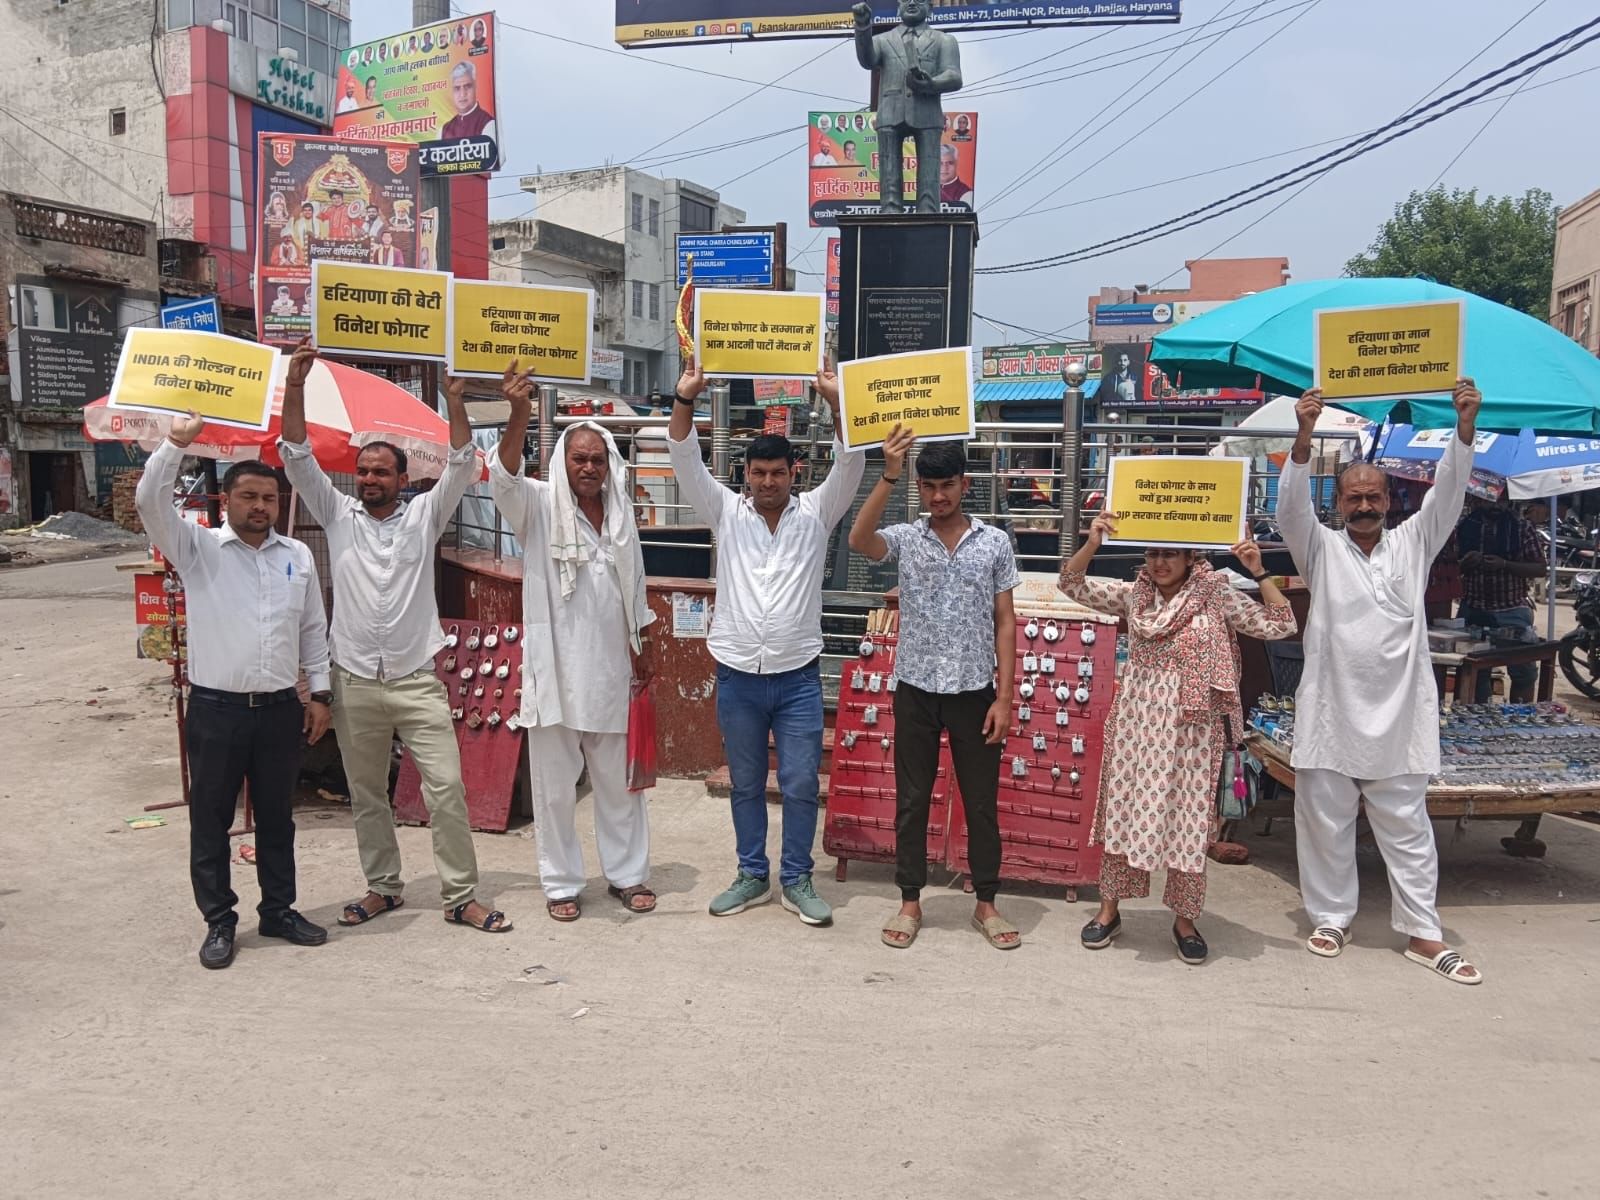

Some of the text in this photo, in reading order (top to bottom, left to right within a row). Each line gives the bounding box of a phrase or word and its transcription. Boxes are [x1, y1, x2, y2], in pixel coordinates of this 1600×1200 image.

[643, 28, 674, 38] Follow
[675, 27, 689, 36] us:
[959, 10, 992, 22] NH-71,
[993, 6, 1046, 19] Delhi-NCR,
[1048, 4, 1092, 17] Patauda,
[1093, 2, 1128, 16] Jhajjar,
[1129, 1, 1174, 13] Haryana
[269, 57, 315, 91] Hotel
[257, 79, 325, 119] Krishna
[276, 143, 289, 154] 15
[430, 138, 490, 163] कटारिया
[814, 178, 851, 197] हार्दिक
[323, 282, 442, 310] हरियाणा की बेटी
[193, 312, 214, 326] निषेध
[481, 306, 560, 323] हरियाणा का मान
[333, 313, 379, 335] विनेश
[383, 318, 430, 339] फोगाट
[490, 321, 550, 337] विनेश फोगाट
[703, 319, 816, 335] विनेश फोगाट के सम्मान में
[30, 335, 51, 344] Vikas
[1347, 328, 1431, 344] हरियाणा का मान
[66, 348, 84, 356] Doors
[461, 339, 478, 353] देश
[480, 340, 492, 354] की
[495, 343, 516, 355] शान
[517, 343, 546, 357] विनेश
[549, 345, 578, 361] फोगाट
[705, 338, 813, 352] आम आदमी पार्टी मैदान में
[1358, 342, 1421, 357] विनेश फोगाट
[67, 357, 94, 365] Windows
[132, 353, 262, 381] INDIA की गोल्डन Girl
[998, 357, 1022, 376] श्याम
[58, 372, 76, 380] Doors
[67, 365, 96, 374] Partitions
[1328, 360, 1450, 379] देश की शान विनेश फोगाट
[66, 381, 87, 389] Works
[154, 373, 234, 397] विनेश फोगाट
[866, 374, 941, 392] हरियाणा का मान
[38, 396, 61, 406] Glazing
[59, 389, 86, 397] Windows
[876, 387, 933, 404] विनेश फोगाट
[852, 404, 961, 427] देश की शान विनेश फोगाट
[1535, 444, 1576, 457] Wires
[1578, 443, 1588, 452] &
[1135, 479, 1216, 491] विनेश फोगाट के साथ
[1139, 492, 1210, 505] क्यों हुआ अन्याय ?
[1132, 511, 1162, 520] सरकार
[1164, 510, 1198, 522] हरियाणा
[1200, 511, 1211, 522] को
[1212, 513, 1233, 523] बताए
[139, 591, 160, 606] शिव
